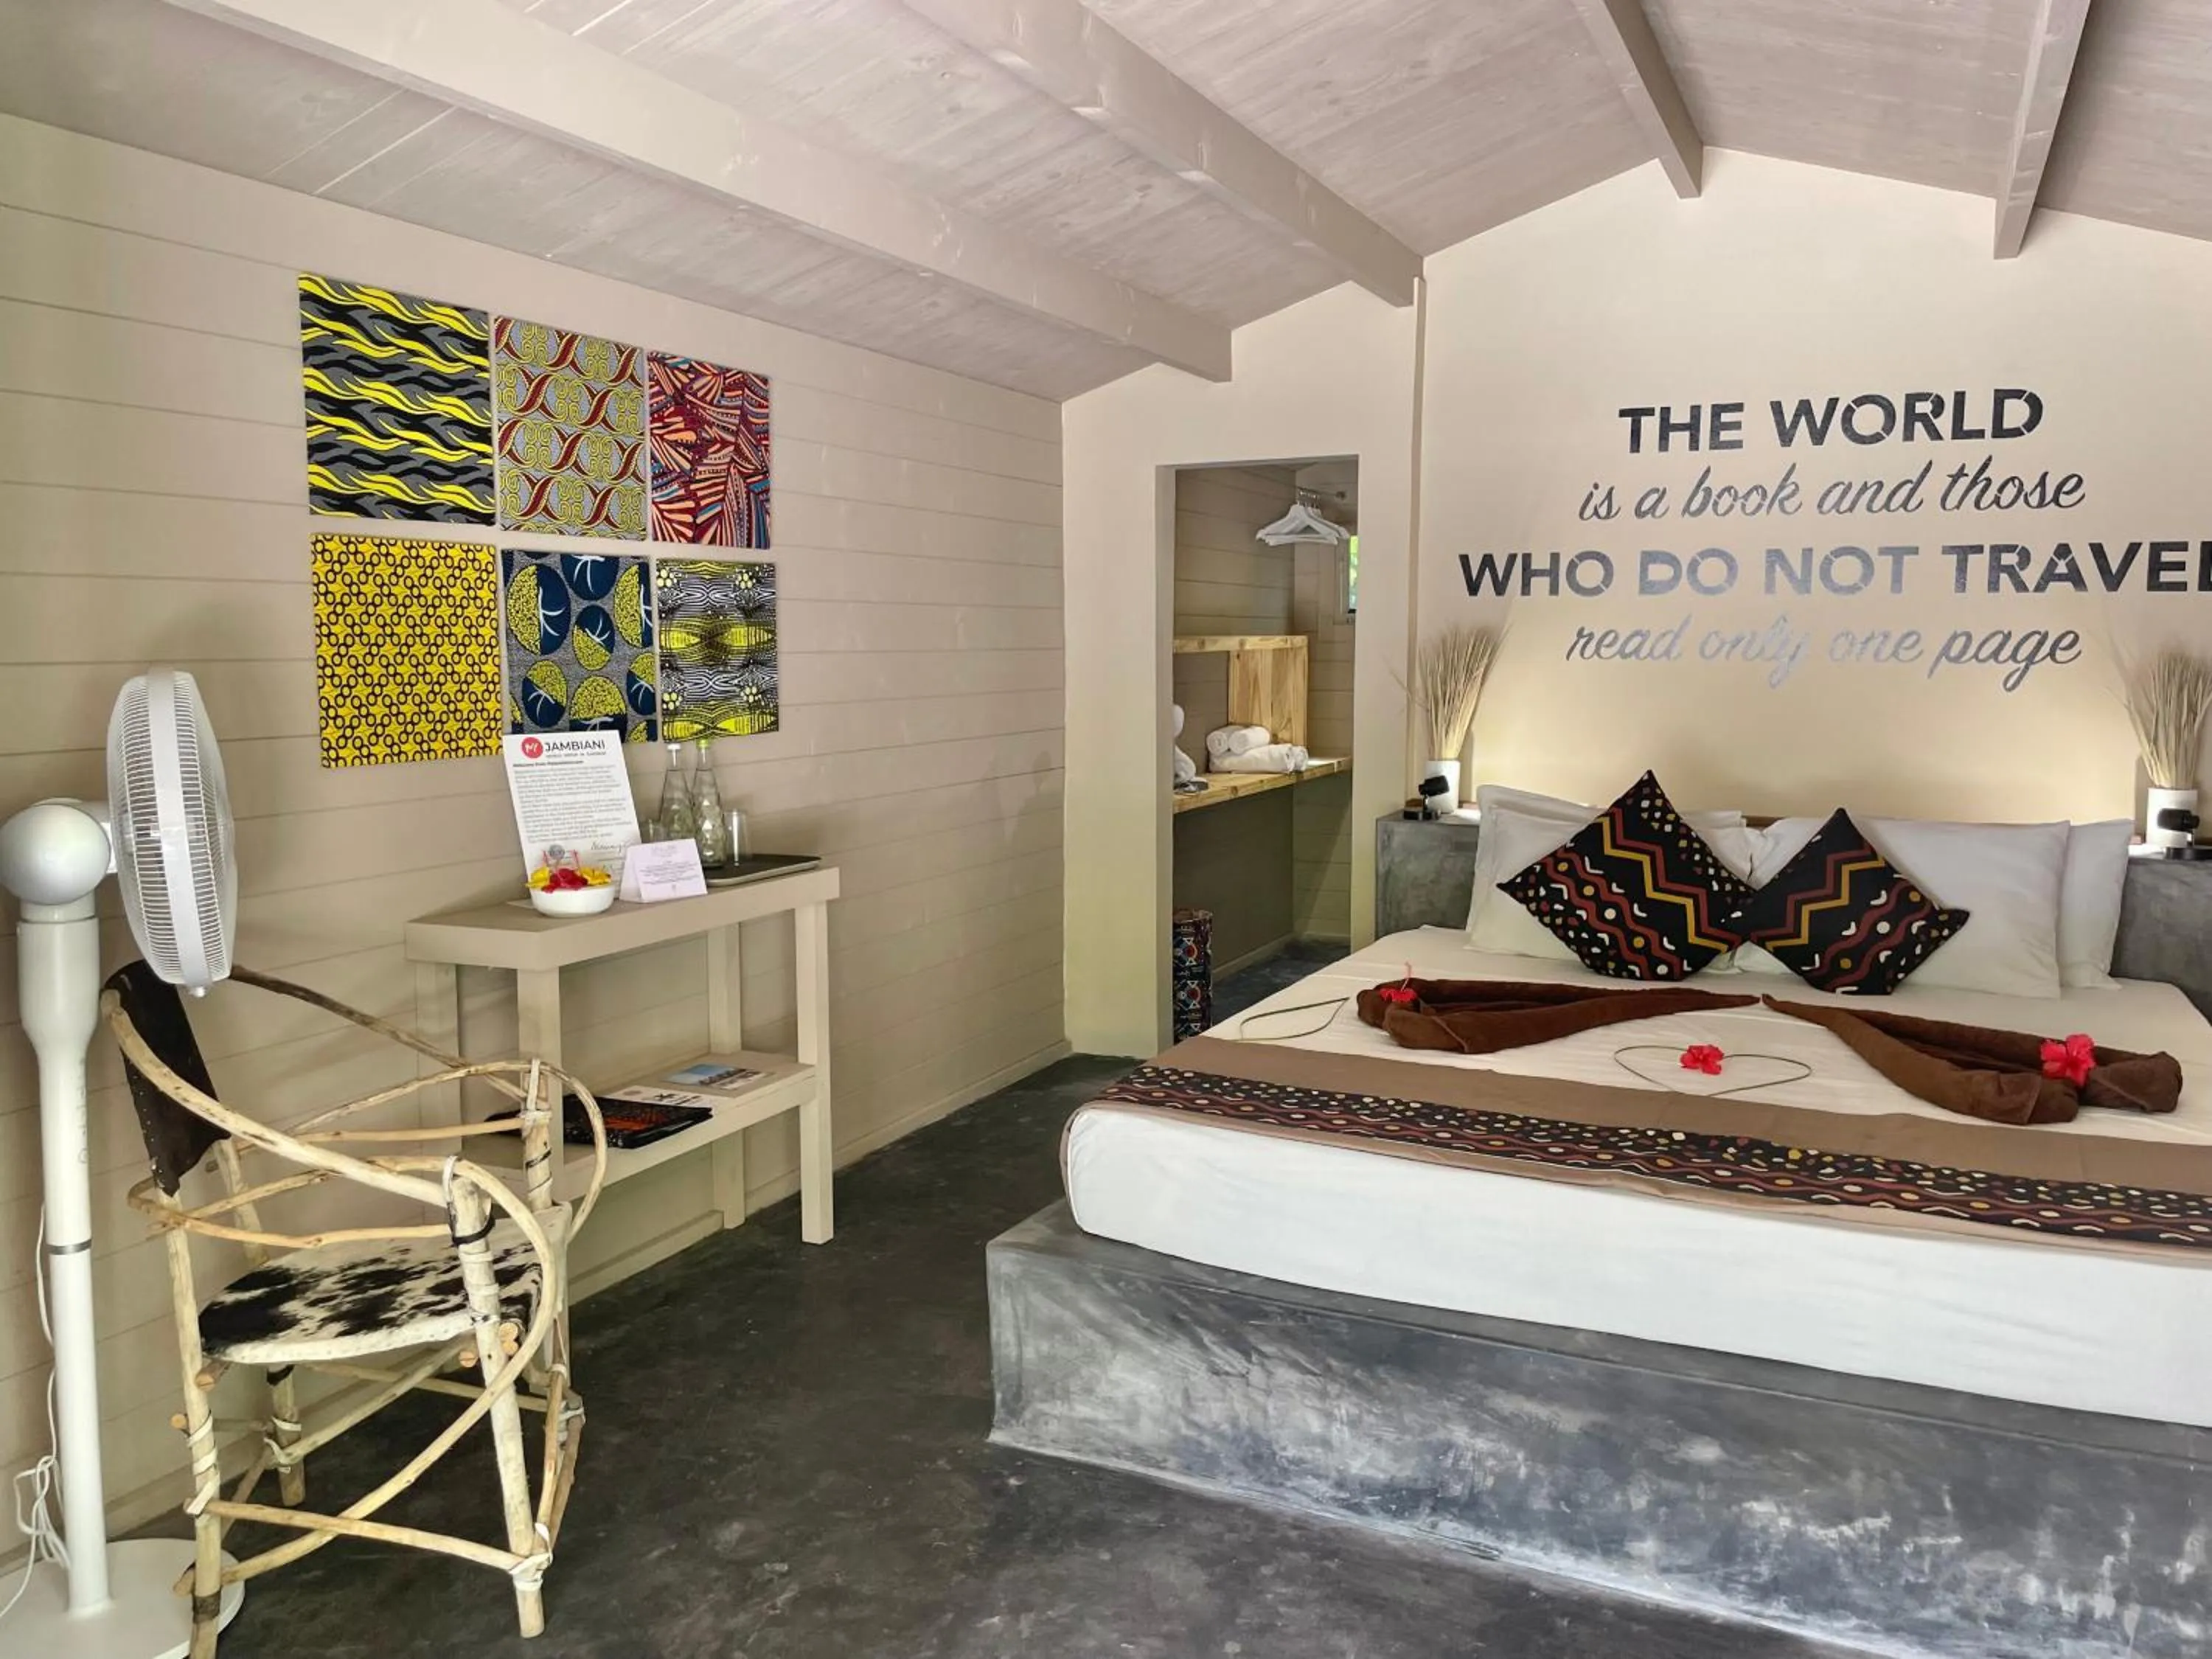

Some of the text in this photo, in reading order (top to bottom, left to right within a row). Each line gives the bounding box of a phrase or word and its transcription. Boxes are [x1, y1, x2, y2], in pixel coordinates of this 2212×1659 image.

[1618, 389, 2043, 453] THE WORLD
[1579, 454, 2086, 521] is a book and those
[1458, 550, 1615, 597] WHO
[1638, 547, 1739, 597] DO
[1764, 545, 1920, 596] NOT
[1565, 613, 2082, 693] read only one page
[544, 739, 605, 751] JAMBIANI
